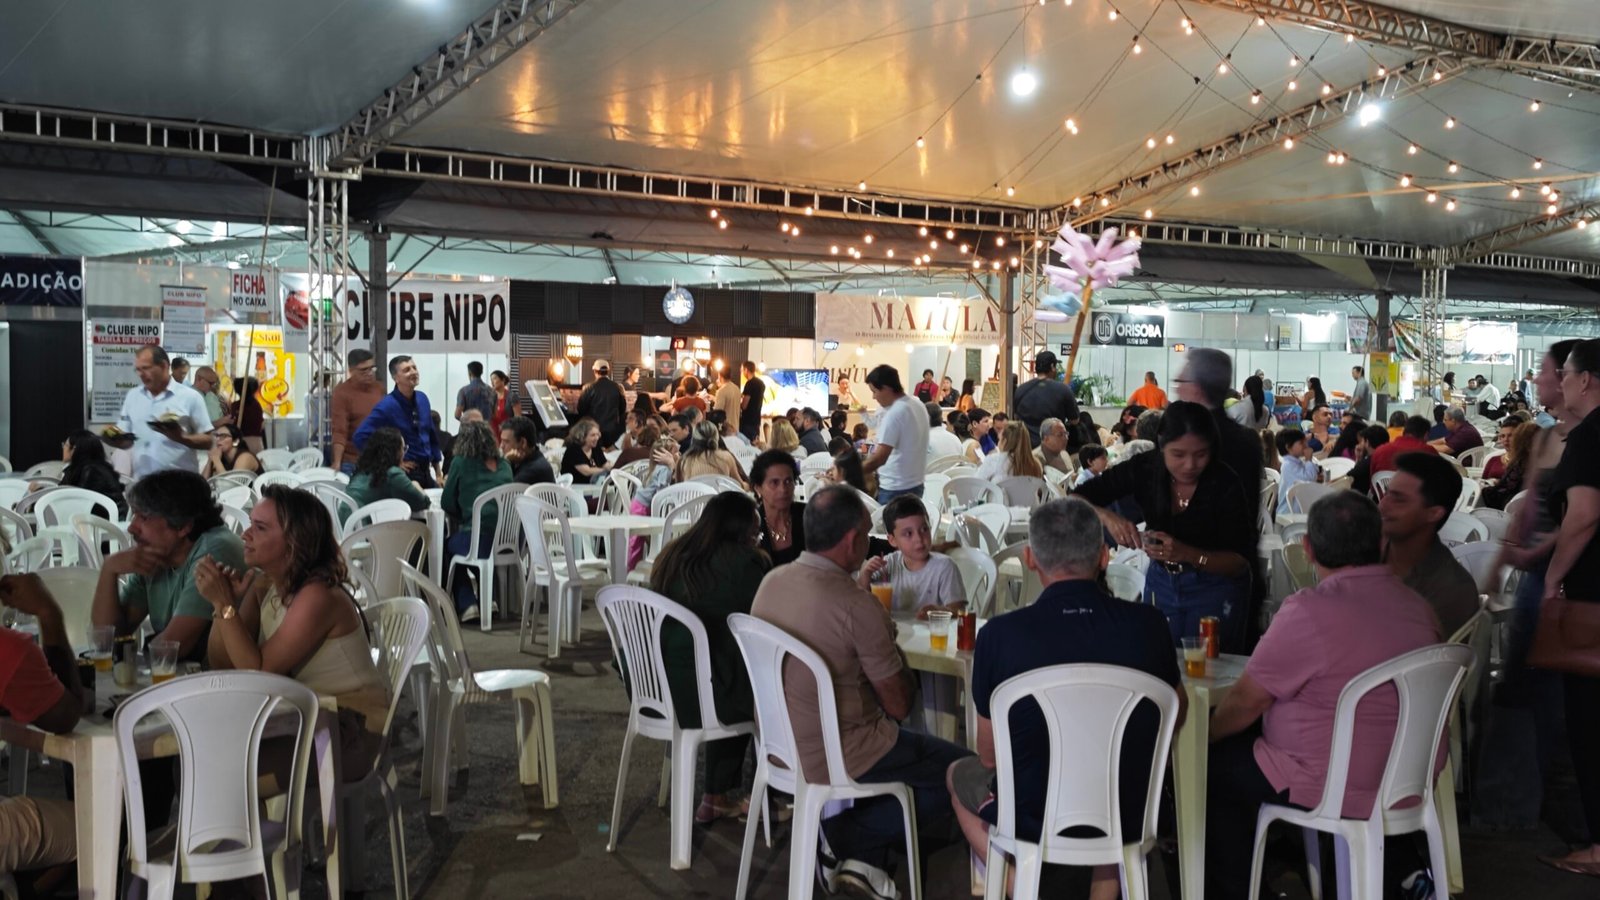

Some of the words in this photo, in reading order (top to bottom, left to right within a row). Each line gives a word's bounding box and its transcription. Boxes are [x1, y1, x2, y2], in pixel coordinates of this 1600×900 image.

[0, 270, 82, 294] ADIÇÃO
[233, 274, 266, 295] FICHA
[233, 296, 243, 306] NO
[245, 297, 267, 307] CAIXA
[443, 292, 506, 342] NIPO
[107, 324, 135, 335] CLUBE
[138, 325, 159, 336] NIPO
[1116, 323, 1161, 338] ORISOBA
